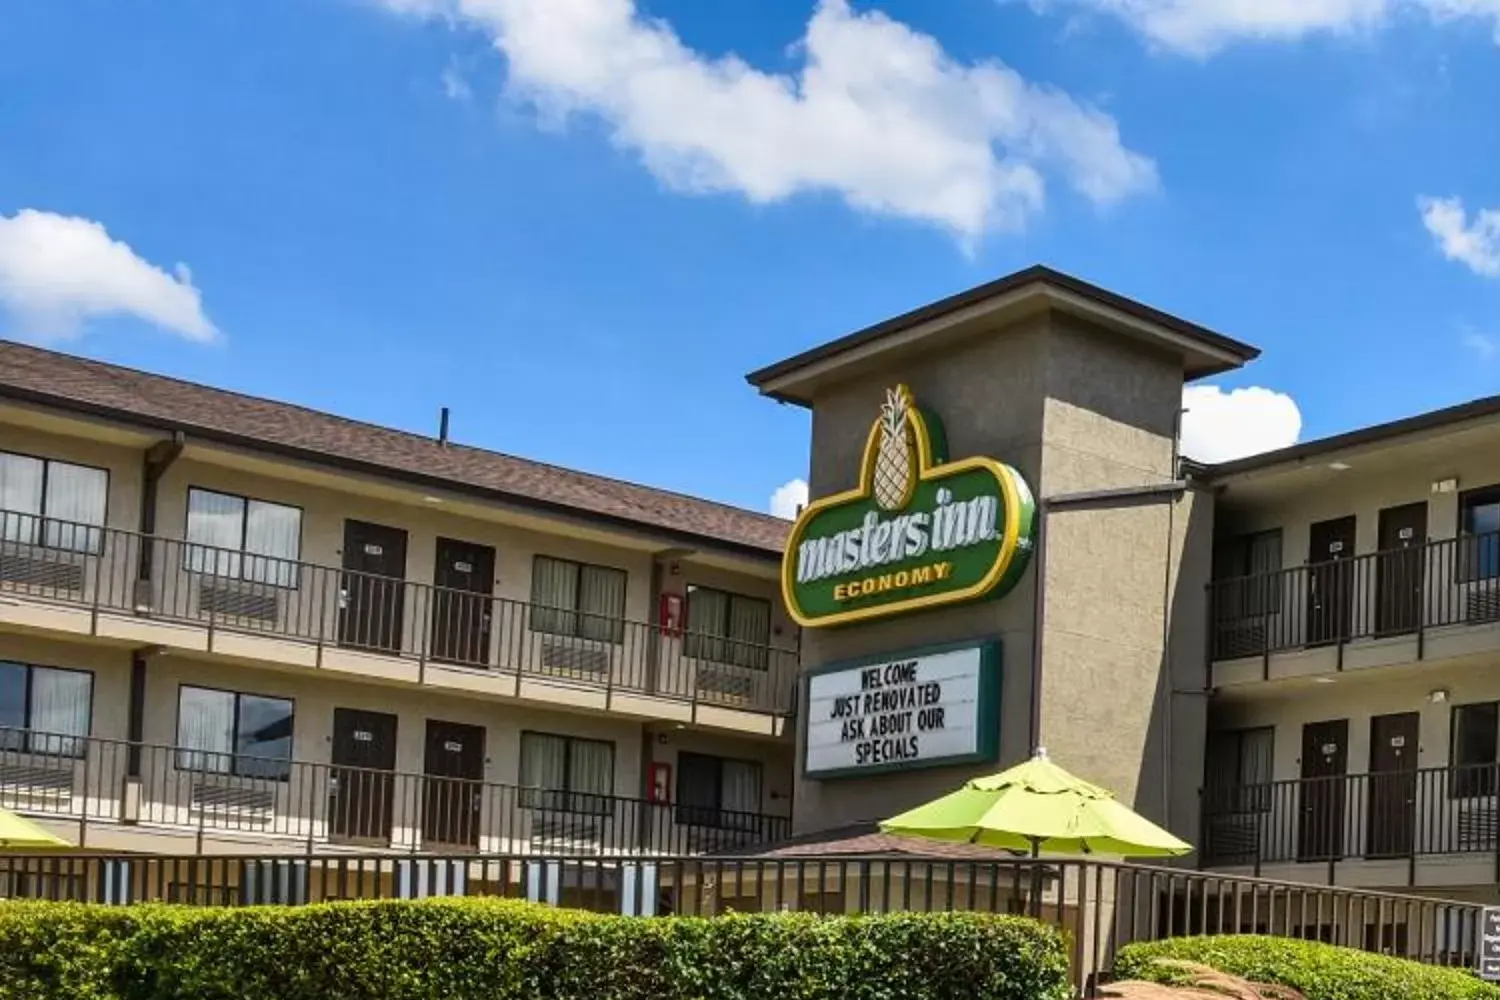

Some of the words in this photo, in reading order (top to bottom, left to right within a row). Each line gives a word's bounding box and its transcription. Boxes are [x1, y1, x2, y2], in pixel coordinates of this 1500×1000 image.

[797, 510, 929, 582] masters
[931, 488, 998, 550] inn
[833, 561, 950, 601] ECONOMY
[861, 661, 918, 690] WELCOME
[830, 697, 860, 719] JUST
[864, 683, 941, 713] RENOVATED
[841, 717, 865, 742] ASK
[870, 711, 913, 737] ABOUT
[917, 707, 945, 731] OUR
[855, 736, 919, 764] SPECIALS
